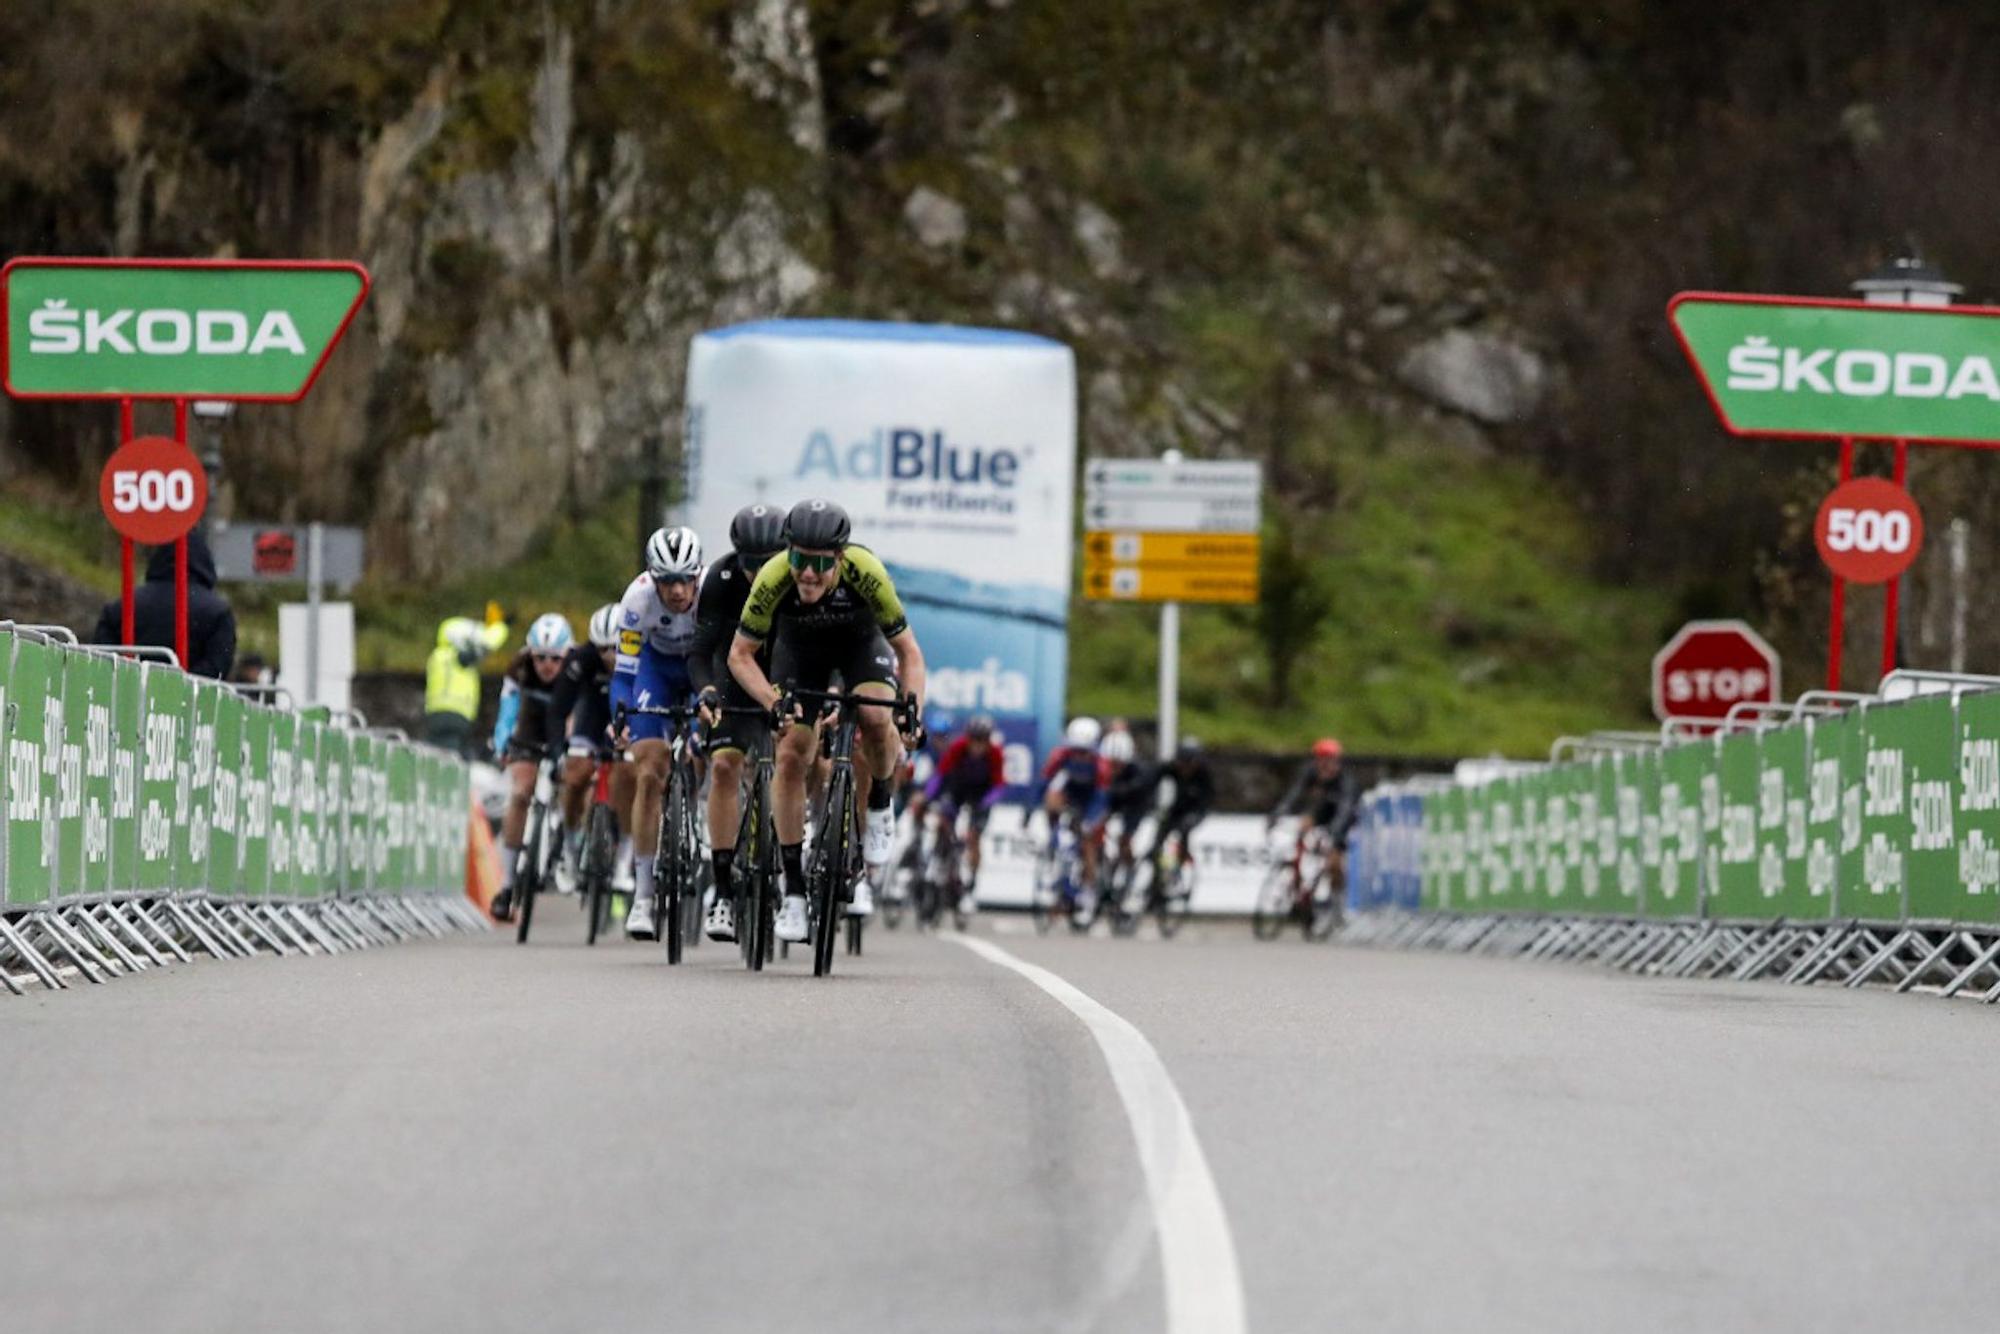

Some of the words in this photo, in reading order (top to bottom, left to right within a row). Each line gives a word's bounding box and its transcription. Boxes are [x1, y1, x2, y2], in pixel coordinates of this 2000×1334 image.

[29, 298, 306, 355] ŠKODA
[1727, 336, 2000, 401] ŠKODA
[795, 426, 1018, 487] AdBlue
[112, 469, 194, 513] 500
[1826, 509, 1911, 553] 500
[1667, 668, 1767, 702] STOP
